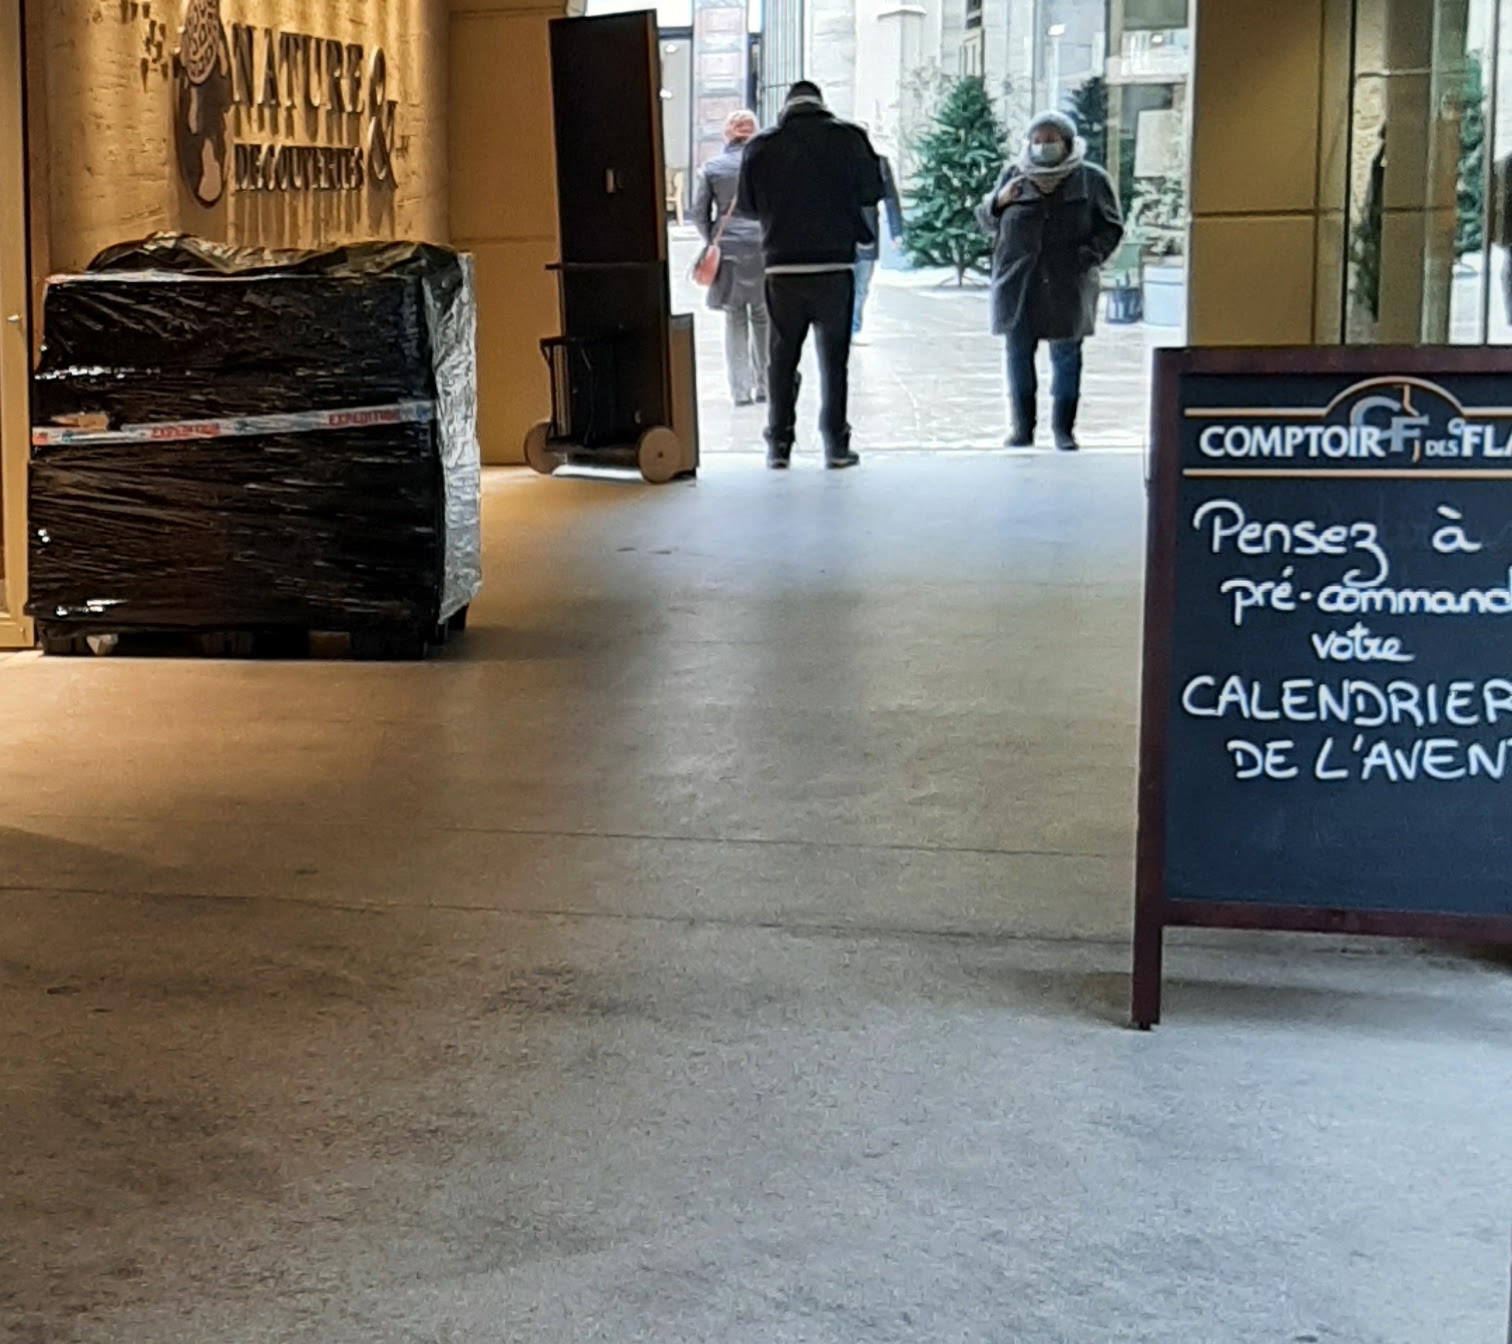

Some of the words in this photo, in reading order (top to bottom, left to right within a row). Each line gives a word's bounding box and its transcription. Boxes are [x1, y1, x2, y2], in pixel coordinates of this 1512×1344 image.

[232, 23, 364, 114] NATURE
[368, 45, 398, 187] &
[1199, 425, 1387, 458] COMPTOIR
[1425, 440, 1460, 457] DES
[1461, 424, 1512, 458] FL
[1193, 499, 1389, 588] Pensez
[1432, 505, 1482, 553] à
[1311, 621, 1416, 662] votre
[1182, 674, 1512, 727] CALENDRIER
[1226, 739, 1299, 779] DE
[1314, 733, 1512, 782] L'AVEN
